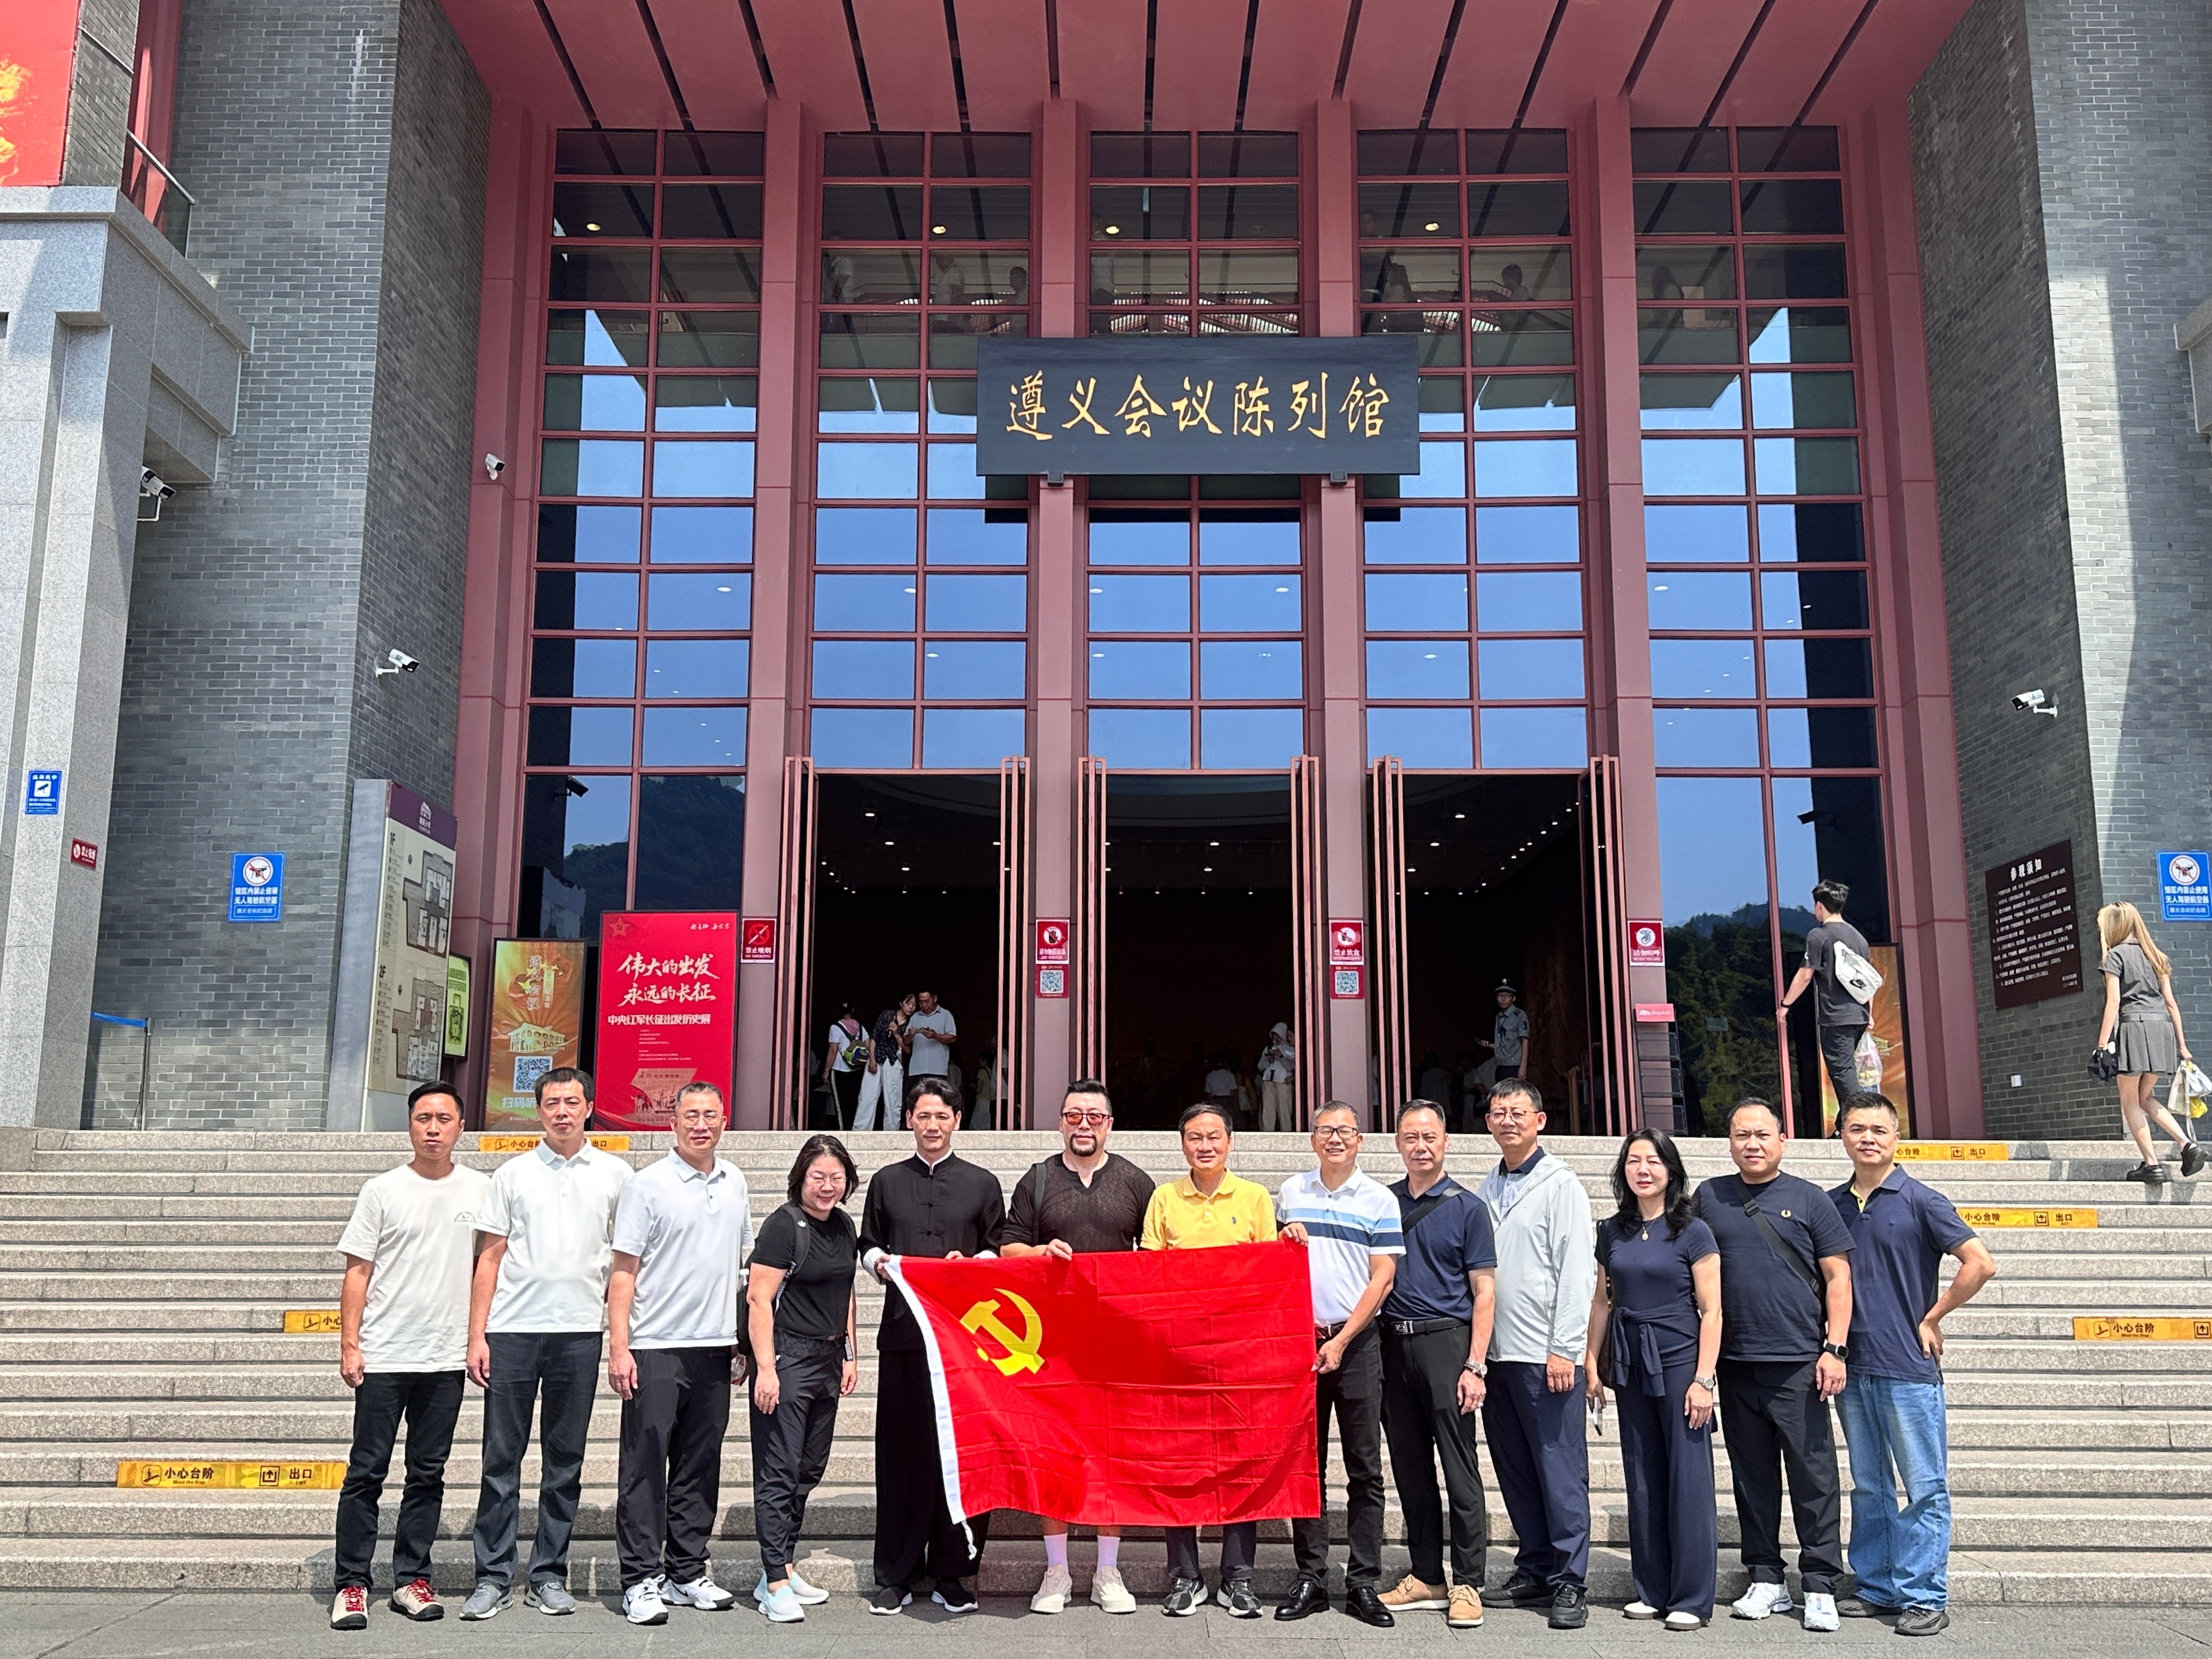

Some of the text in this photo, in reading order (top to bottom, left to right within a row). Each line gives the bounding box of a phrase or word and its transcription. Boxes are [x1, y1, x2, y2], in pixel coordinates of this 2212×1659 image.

[1006, 370, 1390, 441] 遵义会议陈列馆
[390, 832, 396, 846] 1F
[2164, 886, 2208, 894] 馆区内禁止使用
[2165, 895, 2209, 904] 无人驾驶航空器
[379, 965, 386, 978] 2F
[616, 952, 721, 982] 伟大的出发
[617, 981, 717, 1007] 永远的长征
[608, 1014, 712, 1026] 中央红军长征出发历史展
[592, 1139, 607, 1147] 出口
[1965, 1213, 2072, 1221] 小心台阶 出口
[322, 1316, 341, 1325] 小心
[2113, 1323, 2154, 1333] 小心台阶
[165, 1467, 312, 1479] 小心台阶 出口
